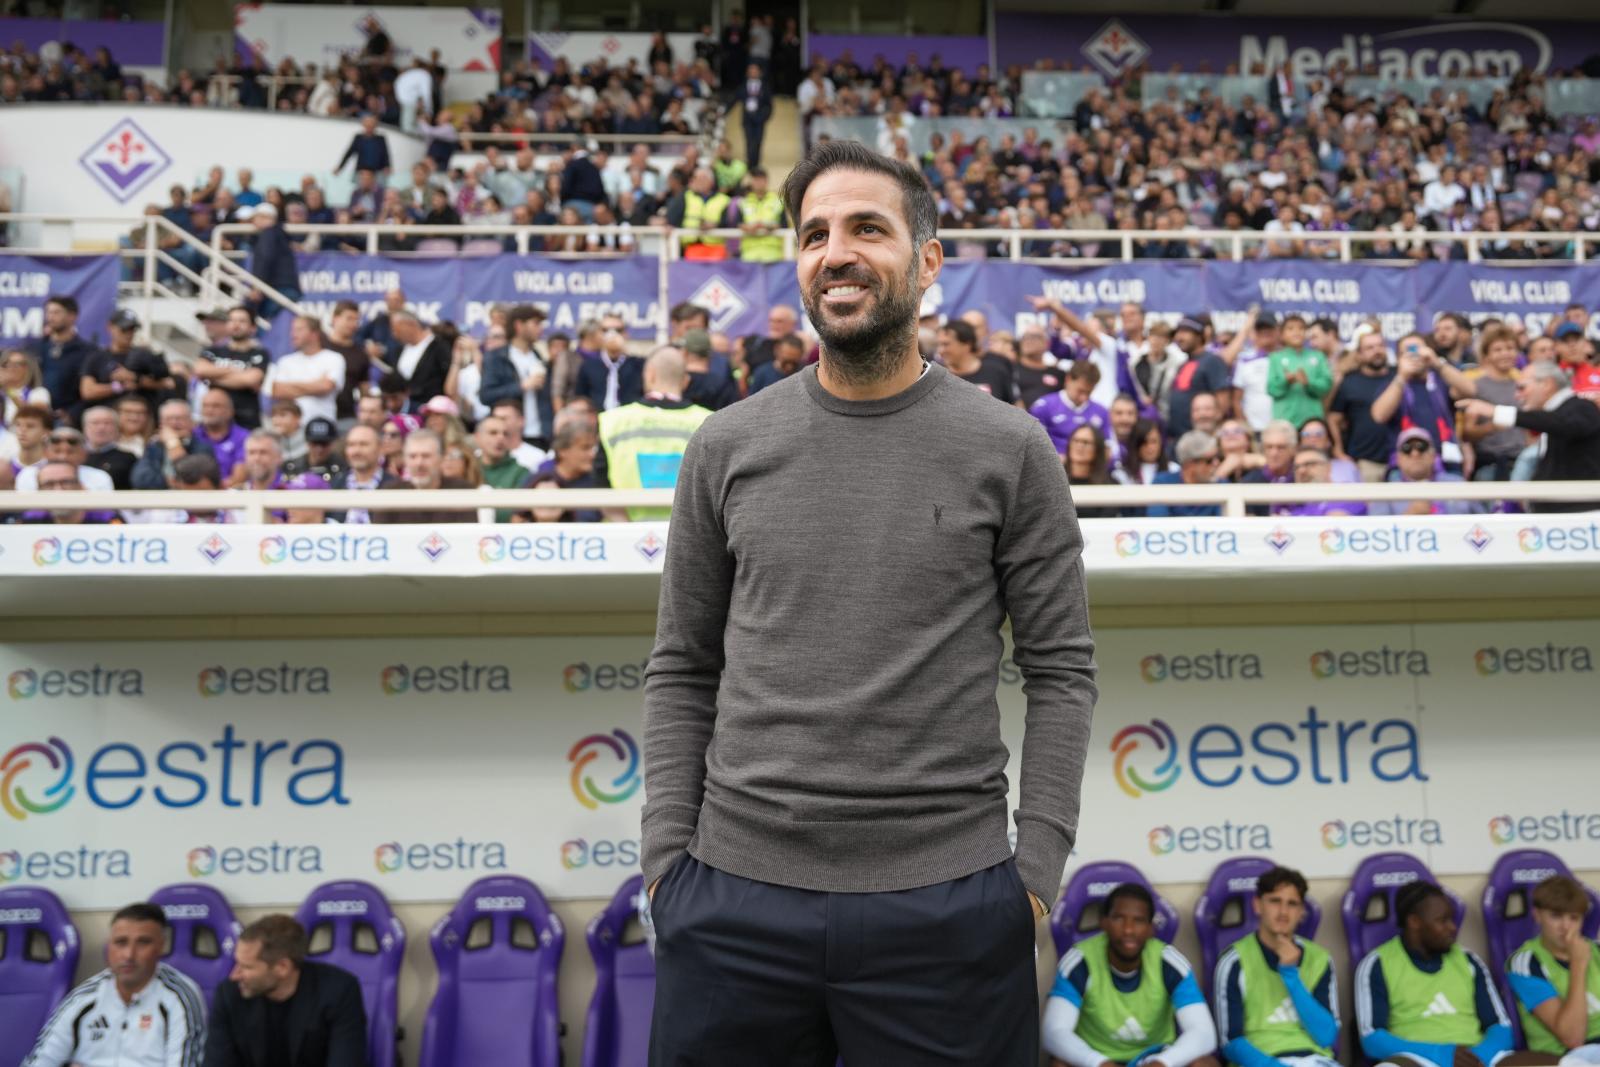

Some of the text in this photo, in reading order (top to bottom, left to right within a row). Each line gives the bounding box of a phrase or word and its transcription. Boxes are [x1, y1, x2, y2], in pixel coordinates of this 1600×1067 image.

[1239, 33, 1522, 83] Mediacom
[353, 270, 399, 293] CLUB
[513, 270, 613, 294] VIOLA CLUB
[1041, 278, 1146, 303] VIOLA CLUB
[1259, 278, 1360, 303] VIOLA CLUB
[1470, 279, 1571, 304] VIOLA CLUB
[65, 532, 169, 564] estra
[289, 532, 390, 563] estra
[508, 530, 608, 562] estra
[1144, 526, 1239, 556] estra
[1348, 523, 1440, 553] estra
[1169, 647, 1263, 682] estra
[1338, 644, 1431, 677] estra
[1503, 641, 1594, 674] estra
[40, 664, 144, 697] estra
[230, 661, 331, 695] estra
[412, 659, 511, 693] estra
[1189, 705, 1430, 788] estra
[85, 723, 351, 809] estra
[1178, 819, 1273, 853] estra
[1350, 813, 1443, 848] estra
[25, 844, 132, 880] estra
[219, 840, 323, 875] estra
[406, 836, 508, 871] estra
